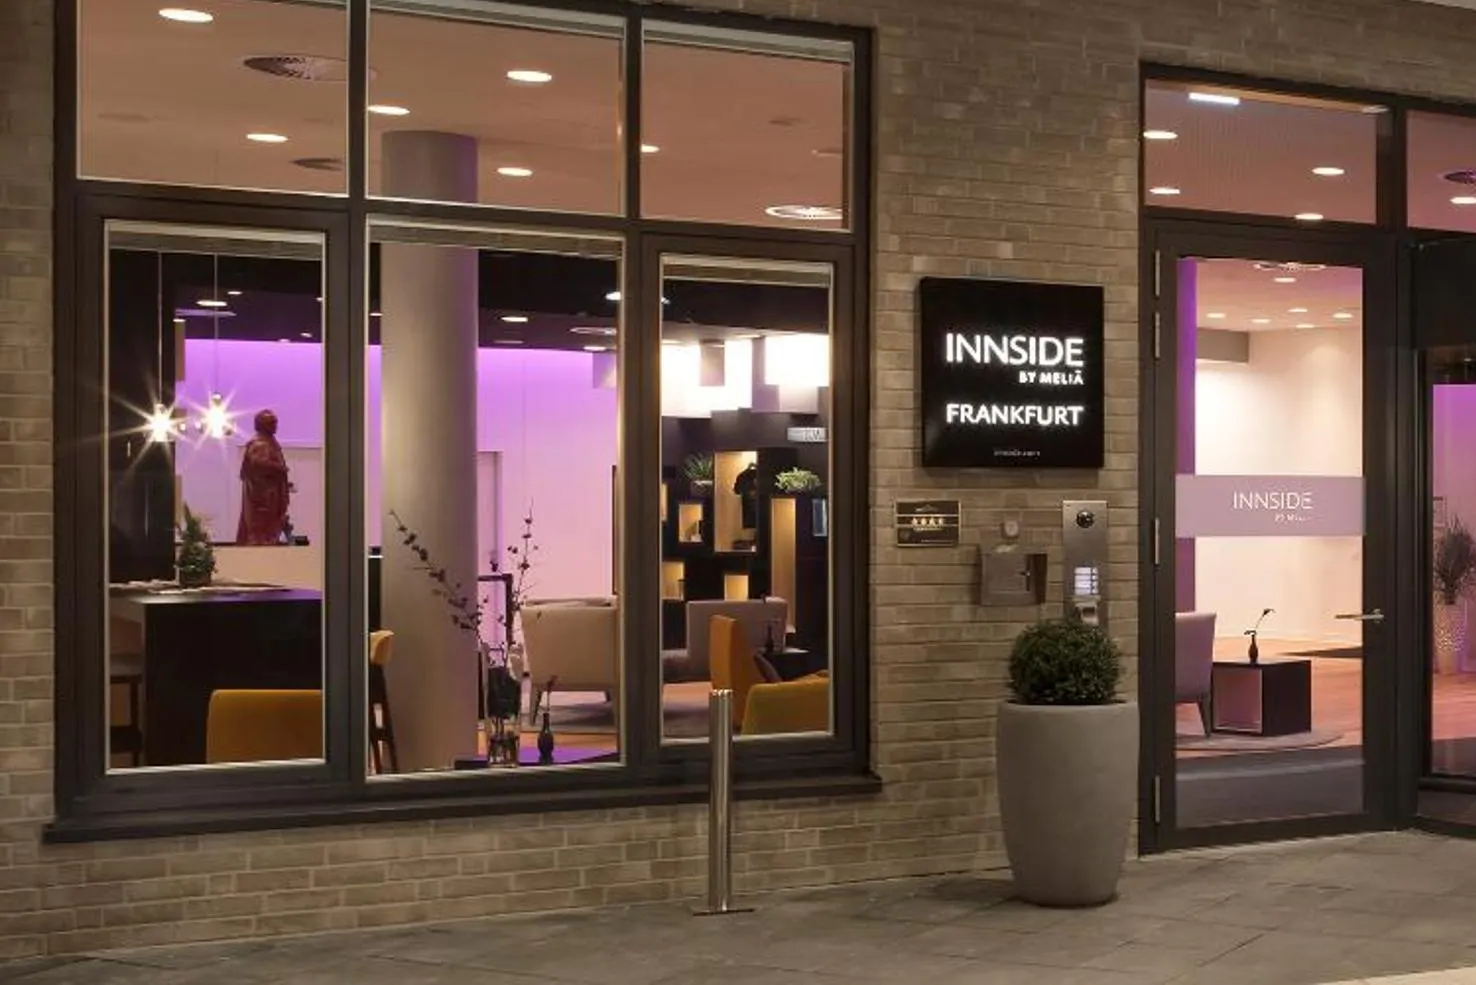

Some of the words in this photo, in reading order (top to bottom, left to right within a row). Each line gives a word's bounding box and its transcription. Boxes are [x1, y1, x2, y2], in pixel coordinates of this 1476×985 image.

[946, 332, 1084, 367] INNSIDE
[1018, 370, 1037, 384] BY
[946, 403, 1084, 426] FRANKFURT
[1233, 491, 1314, 510] INNSIDE
